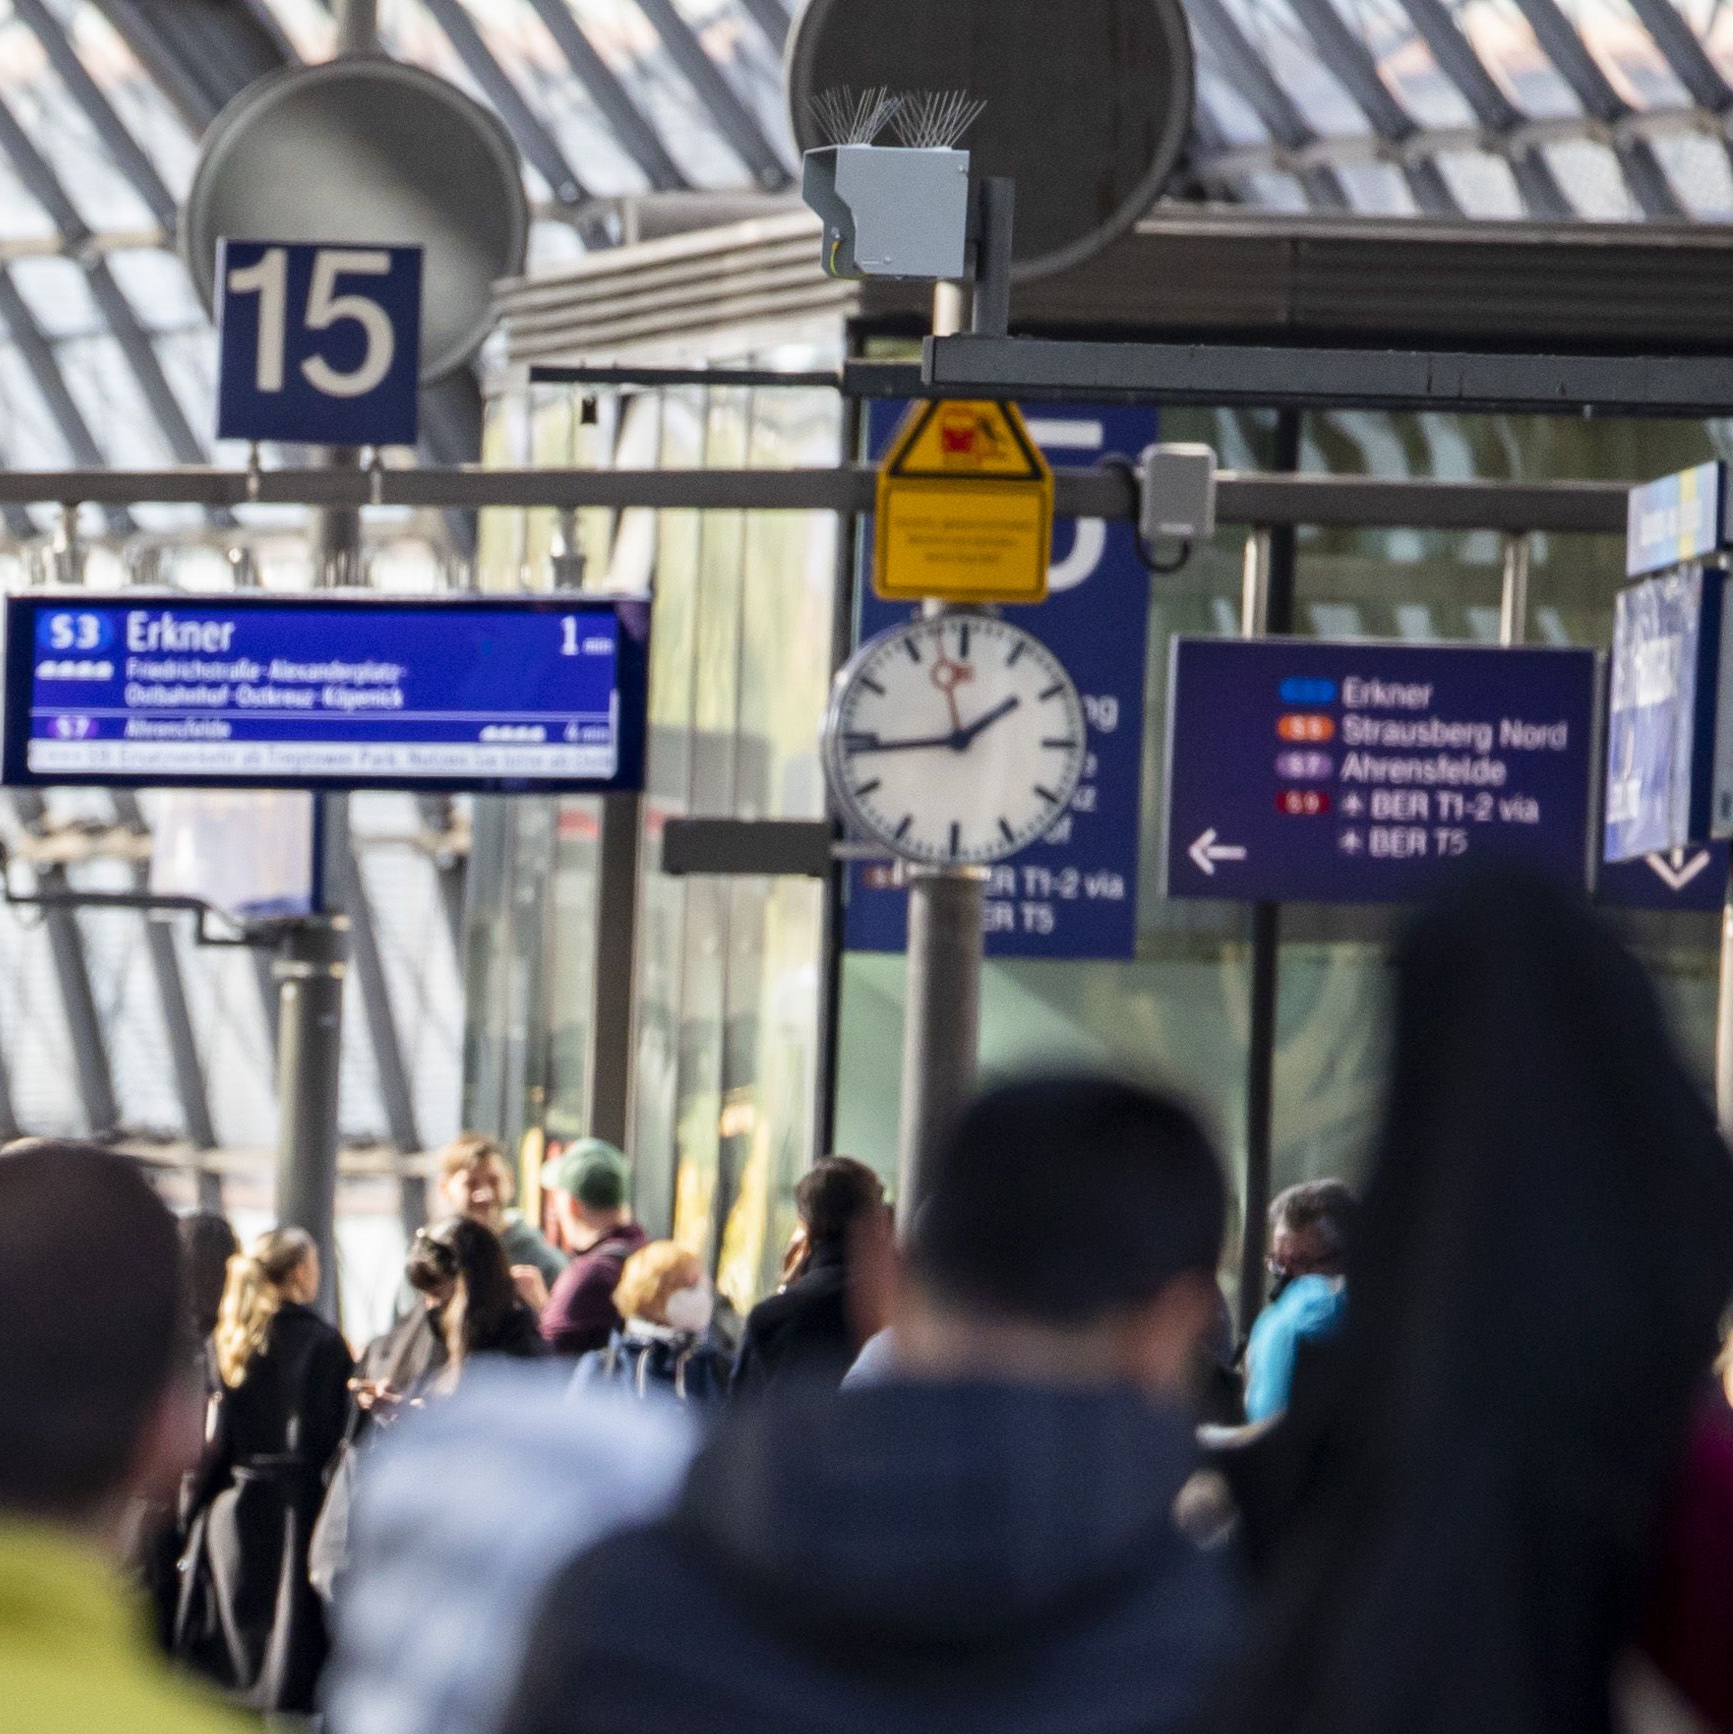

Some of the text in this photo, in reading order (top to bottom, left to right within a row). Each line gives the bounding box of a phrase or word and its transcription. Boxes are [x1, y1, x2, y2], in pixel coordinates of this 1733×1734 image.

[228, 247, 394, 398] 15
[126, 610, 235, 653] Erkner
[1342, 676, 1432, 709] Erkner
[1341, 713, 1493, 753] Strausberg
[1499, 718, 1568, 750] Nord
[1339, 752, 1507, 786] Ahrensfelde
[1370, 788, 1429, 821] BER
[1437, 789, 1494, 822] T1-2
[1499, 792, 1540, 825] via
[1369, 826, 1469, 858] BER T5
[1024, 865, 1079, 899] T1-2
[1084, 869, 1125, 899] via
[1023, 903, 1055, 935] T5
